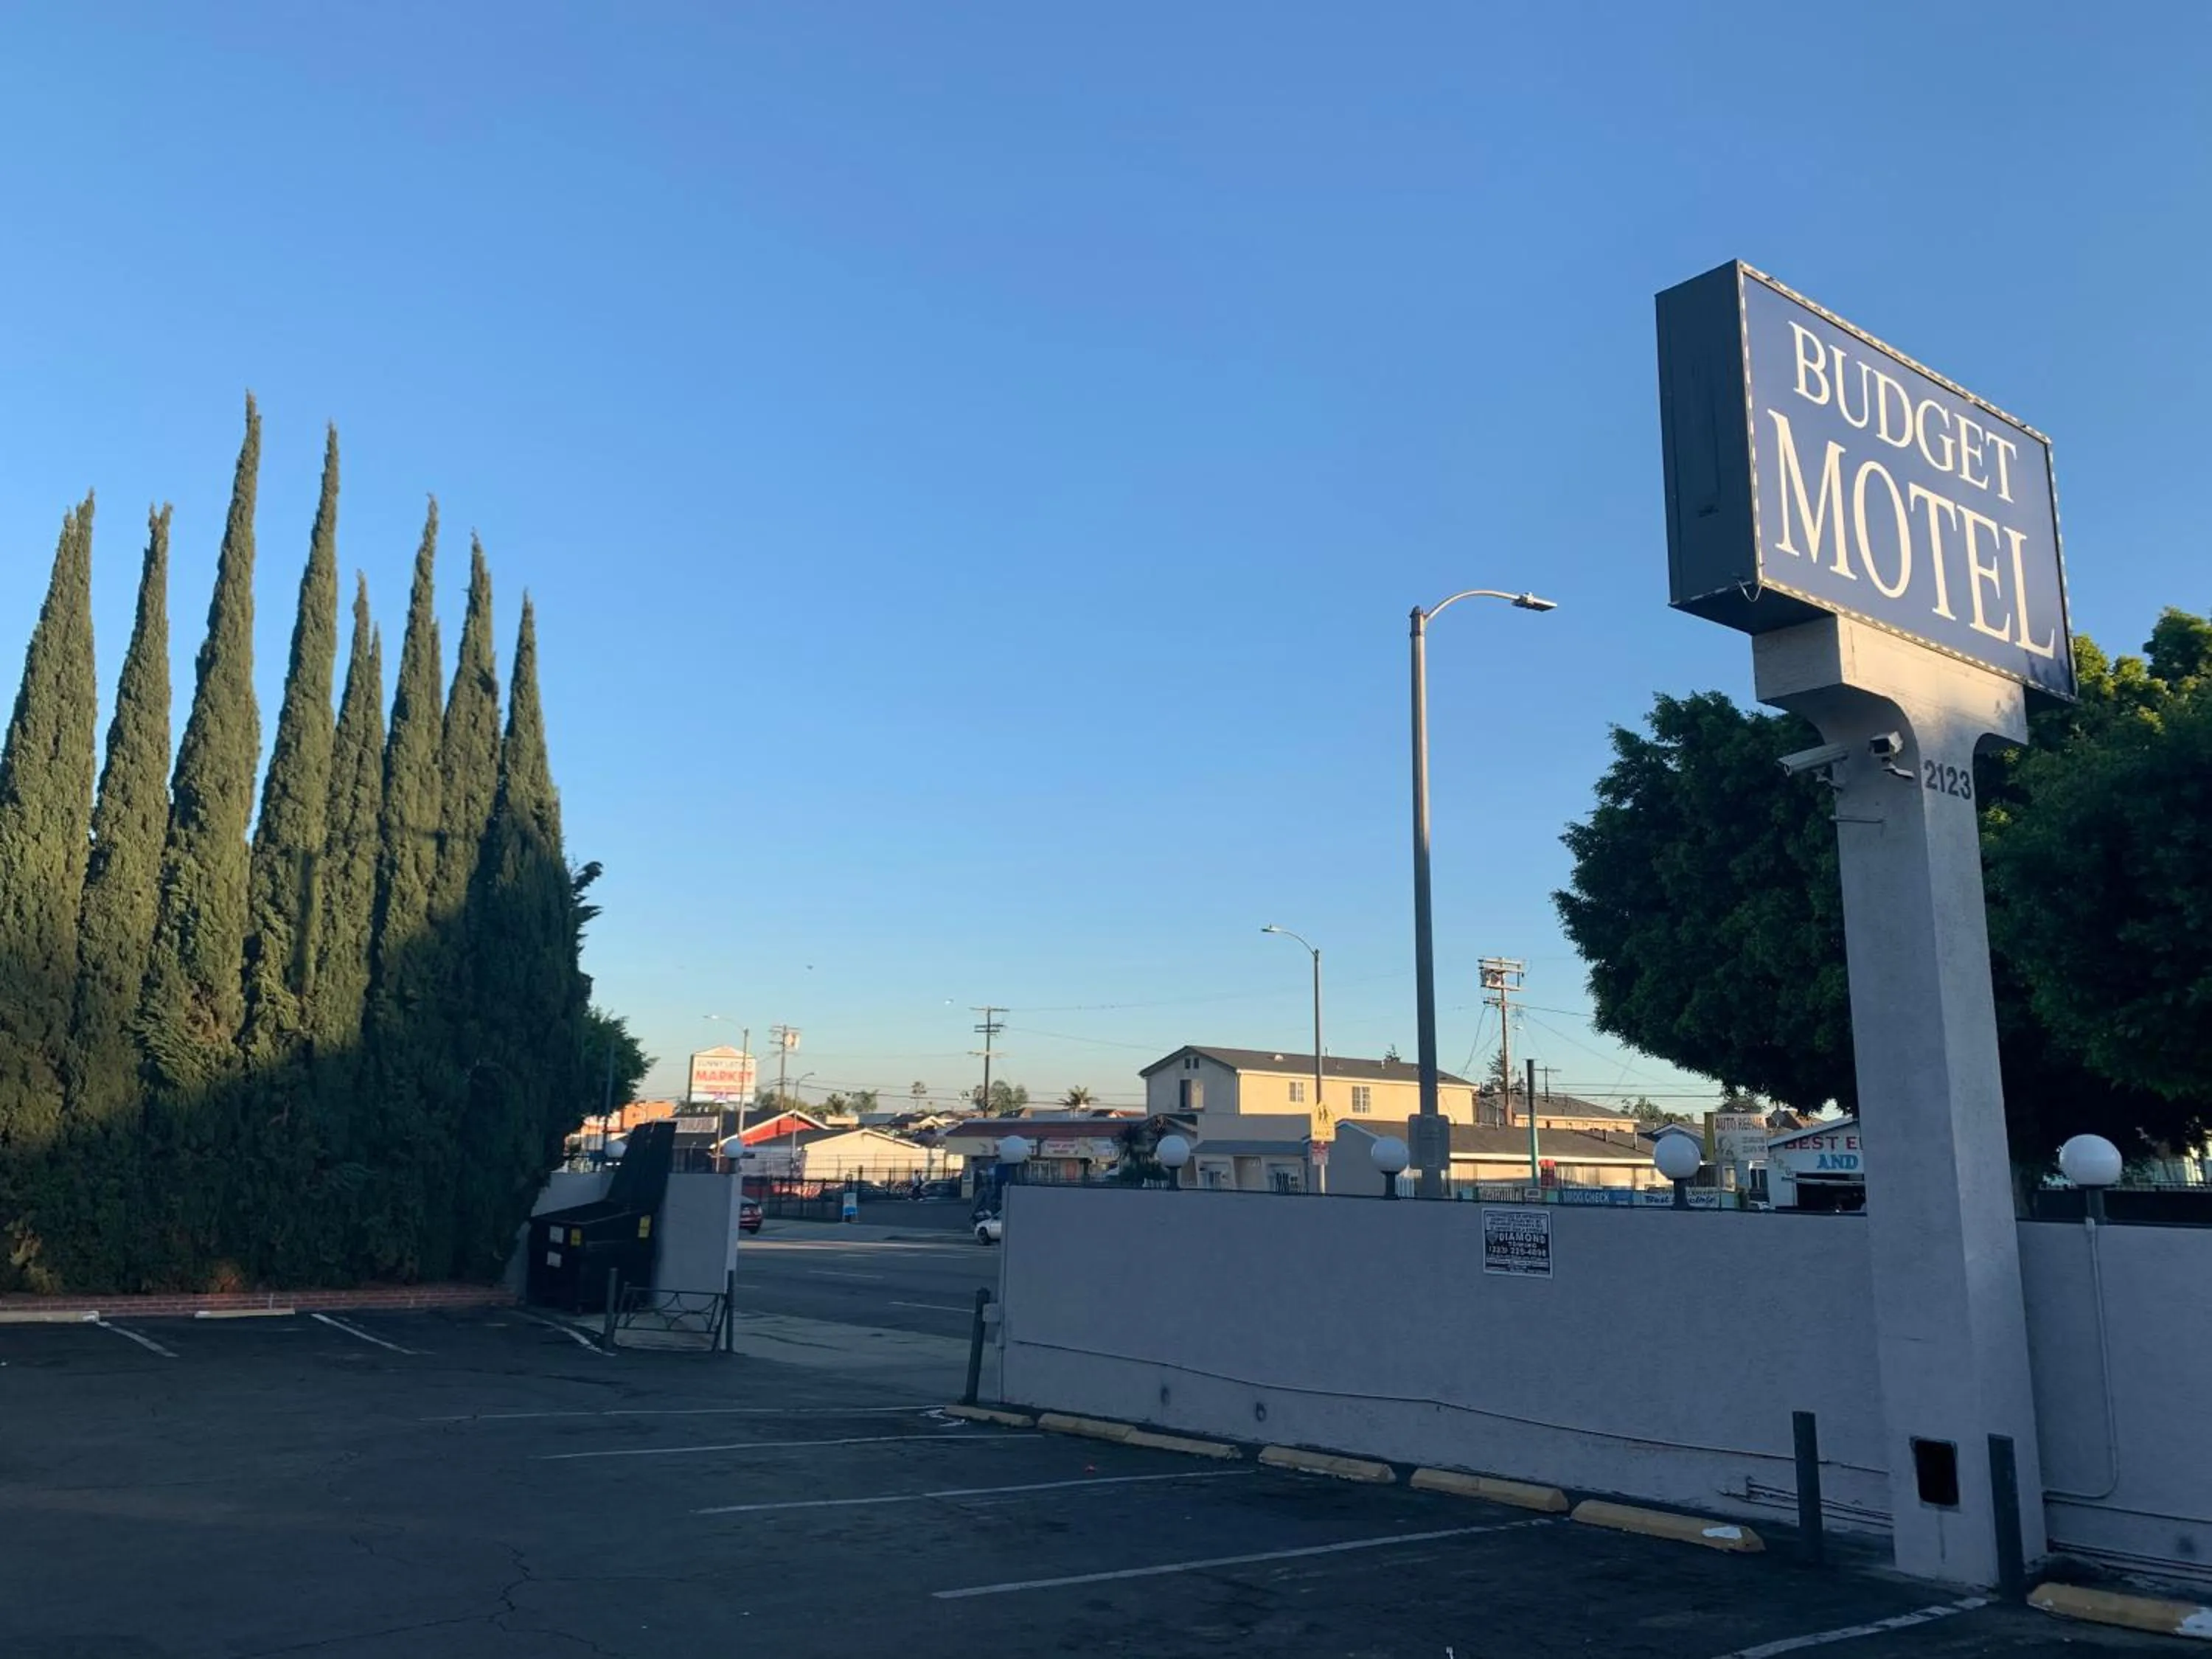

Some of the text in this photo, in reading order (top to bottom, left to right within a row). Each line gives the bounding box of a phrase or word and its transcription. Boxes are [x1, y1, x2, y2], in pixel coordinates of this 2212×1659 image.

[1788, 320, 2017, 504] BUDGET
[1767, 408, 2056, 658] MOTEL
[1924, 760, 1972, 800] 2123
[695, 1071, 754, 1082] MARKET
[1715, 1117, 1739, 1130] AUTO
[1785, 1135, 1839, 1150] BEST
[1817, 1154, 1858, 1170] AND
[1585, 1191, 1610, 1203] CHECK
[1499, 1232, 1546, 1244] DIAMOND
